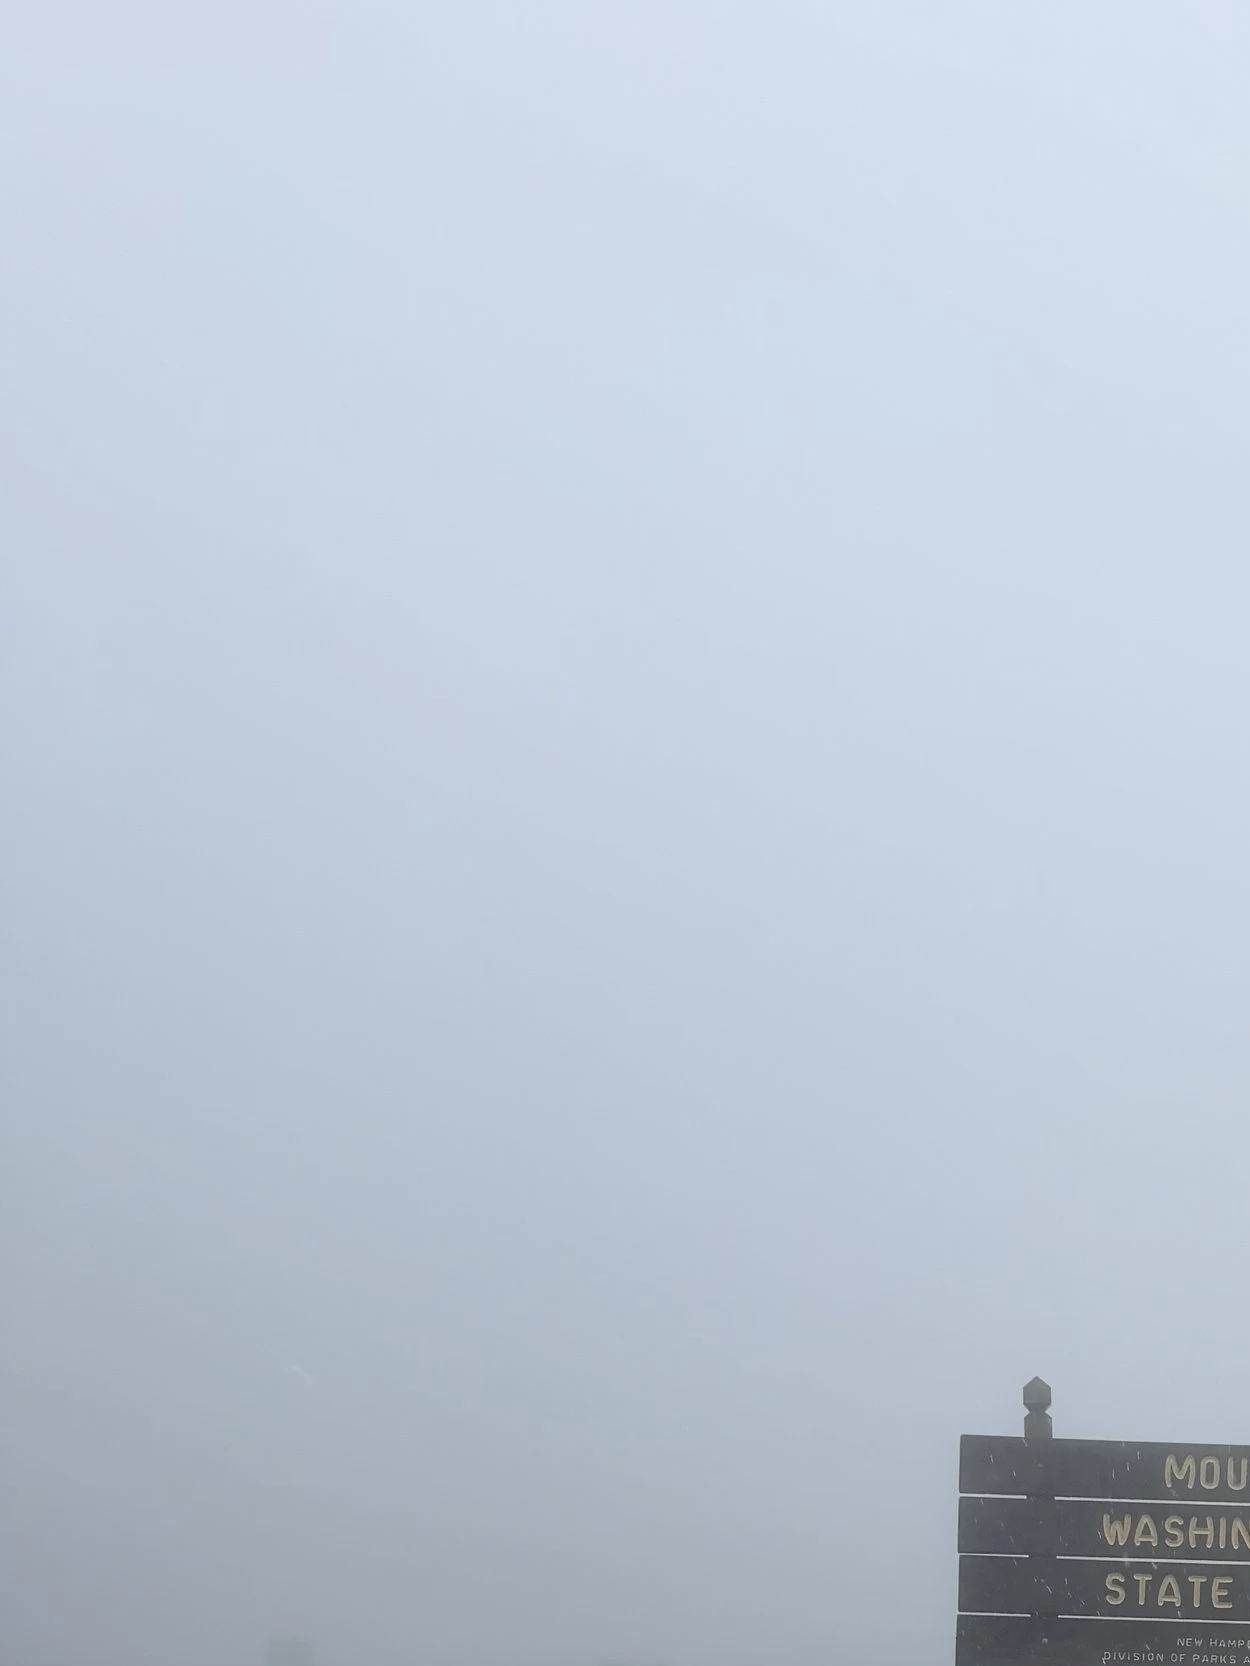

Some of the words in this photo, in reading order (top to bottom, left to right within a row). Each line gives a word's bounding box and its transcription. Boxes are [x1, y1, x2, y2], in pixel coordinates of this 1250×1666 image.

[1105, 1572, 1234, 1608] STATE
[1176, 1637, 1203, 1648] NEW
[1103, 1651, 1164, 1662] DIVISION
[1170, 1653, 1186, 1663] OF
[1192, 1654, 1237, 1665] PARKS
